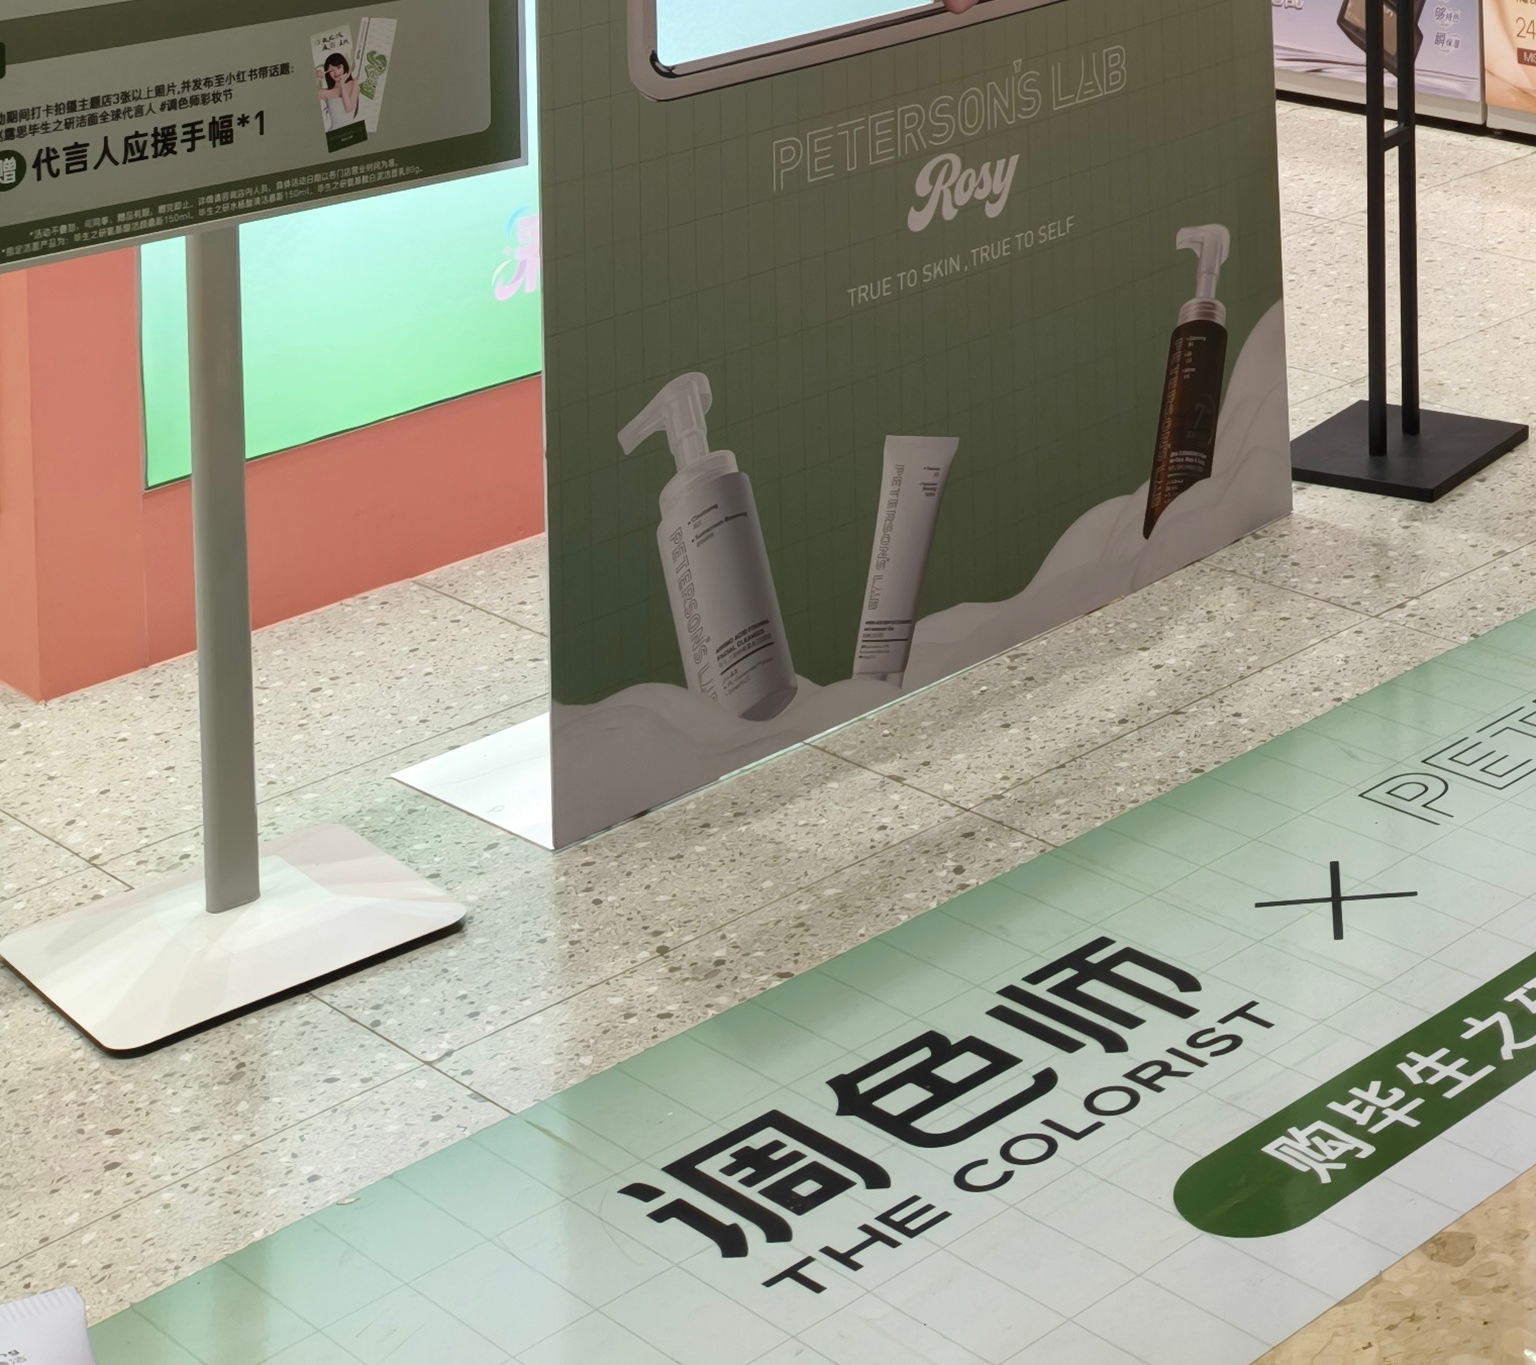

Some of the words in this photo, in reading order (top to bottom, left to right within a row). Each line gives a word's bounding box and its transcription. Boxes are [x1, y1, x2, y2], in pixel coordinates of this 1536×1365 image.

[772, 59, 1043, 193] PETERSON'S
[1051, 44, 1129, 113] LAB
[907, 152, 1021, 233] Rosy
[847, 277, 892, 308] TRUE
[897, 268, 919, 294] TO
[970, 241, 1012, 269] TRUE
[1014, 230, 1036, 255] TO
[1038, 215, 1077, 246] SELF
[617, 936, 1203, 1259] 调色师
[761, 1193, 952, 1295] THE
[952, 1000, 1277, 1193] COLORIST
